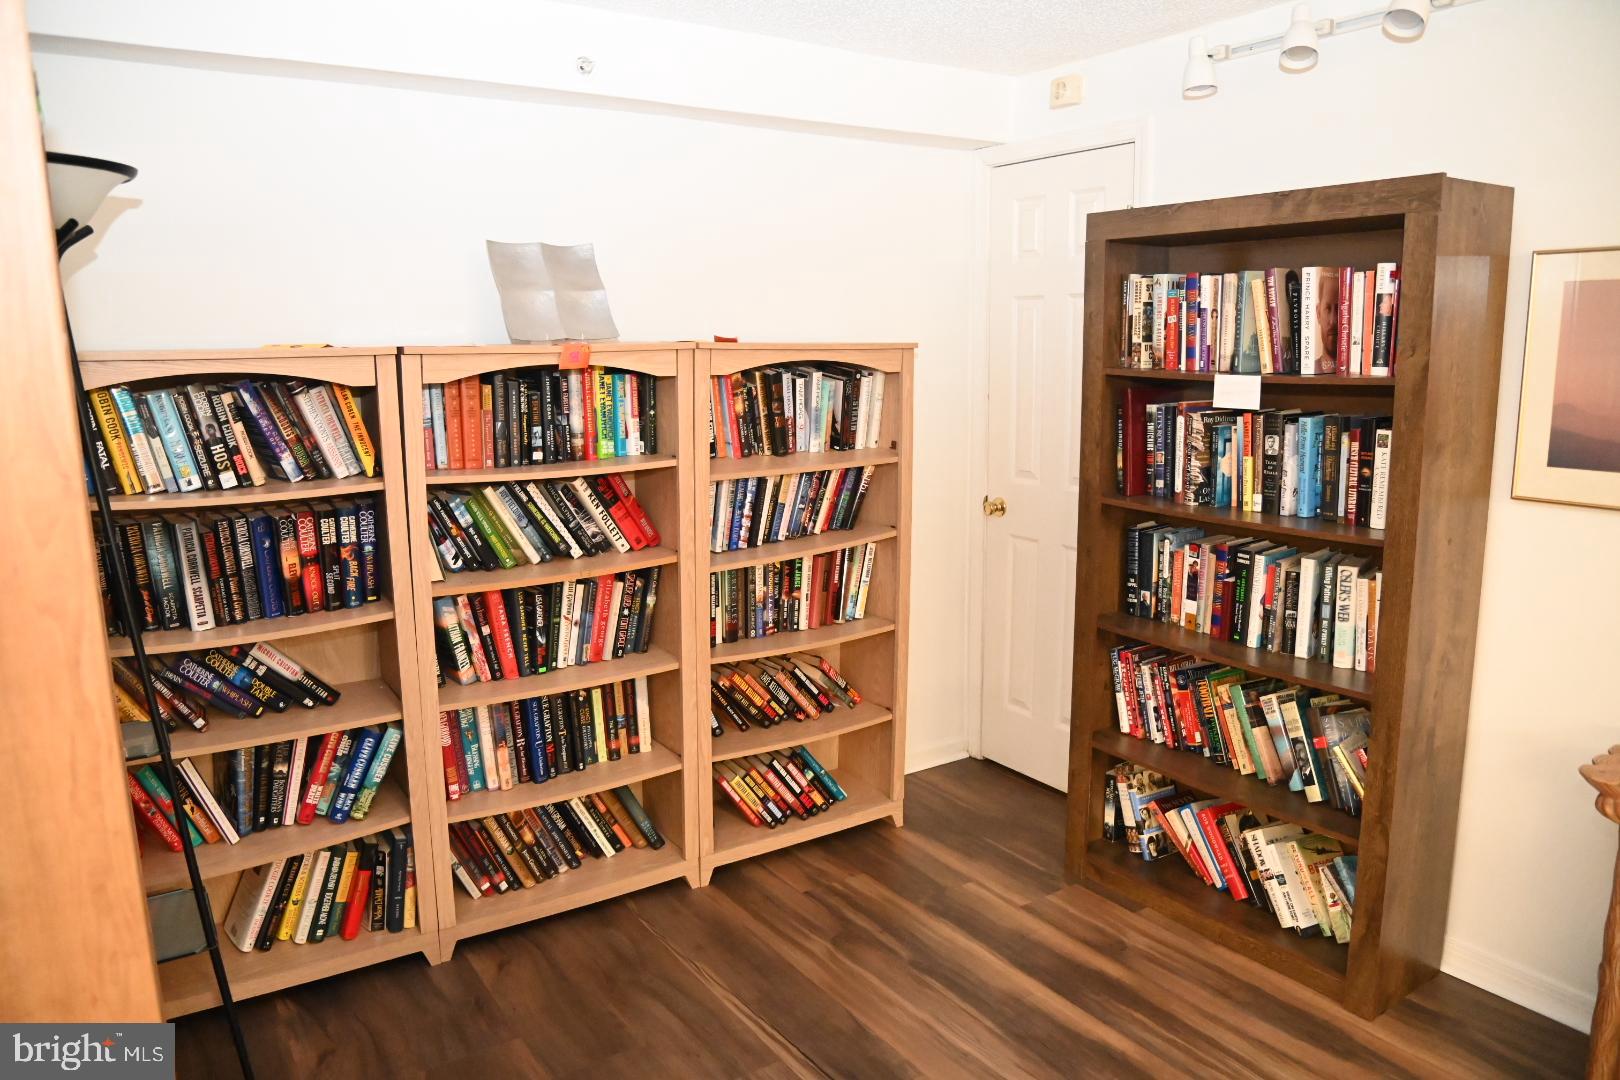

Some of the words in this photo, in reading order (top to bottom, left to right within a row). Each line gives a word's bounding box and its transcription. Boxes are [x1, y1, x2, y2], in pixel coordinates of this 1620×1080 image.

[1341, 301, 1349, 323] Agatha
[1340, 324, 1349, 352] Christie
[199, 391, 213, 416] ROBIN
[106, 417, 121, 441] COOK
[212, 395, 227, 421] ROBIN
[223, 425, 237, 448] COOK
[1146, 422, 1155, 451] SWITCHING
[96, 441, 111, 470] FATAL
[210, 444, 232, 473] HOS
[320, 518, 331, 545] COULTER
[340, 516, 349, 544] COULTER
[359, 511, 369, 544] COULTER
[366, 511, 377, 543] CATHERINE
[588, 492, 601, 510] KEN
[598, 509, 623, 542] FOLLETT
[182, 527, 194, 553] PATRICIA
[298, 518, 309, 553] COULTER
[187, 554, 200, 585] CORNWELL
[1323, 585, 1332, 603] Patton
[1339, 569, 1353, 602] OSLER'S
[1337, 604, 1351, 623] WEB
[1367, 629, 1375, 661] OASIS
[180, 665, 211, 687] COULTER
[543, 710, 552, 742] GRAFTON
[1250, 833, 1266, 867] SHADOW
